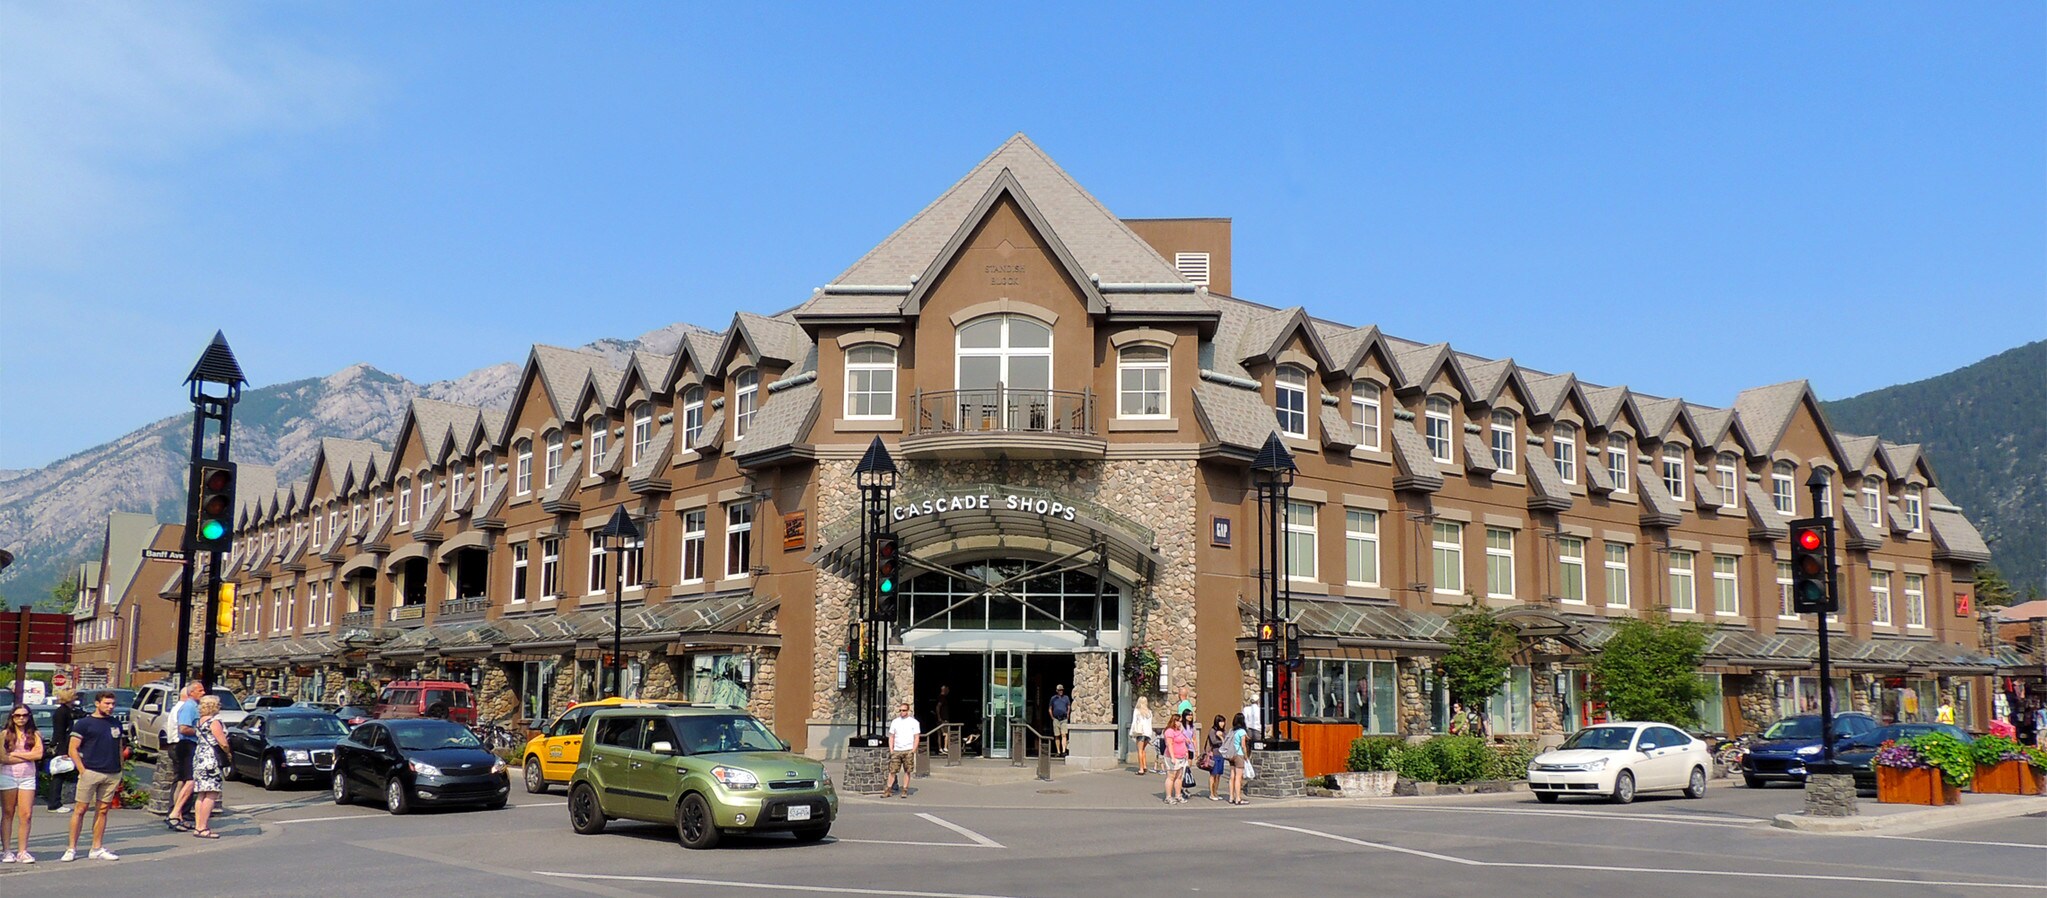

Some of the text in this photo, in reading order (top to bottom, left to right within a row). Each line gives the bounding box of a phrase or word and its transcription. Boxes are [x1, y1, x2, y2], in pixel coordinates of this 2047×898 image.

[984, 264, 1025, 273] STANDISH
[991, 277, 1019, 286] BLOCK
[893, 494, 1077, 521] CASCADE SHOPS
[1216, 522, 1228, 538] GAP
[145, 550, 168, 558] Banff
